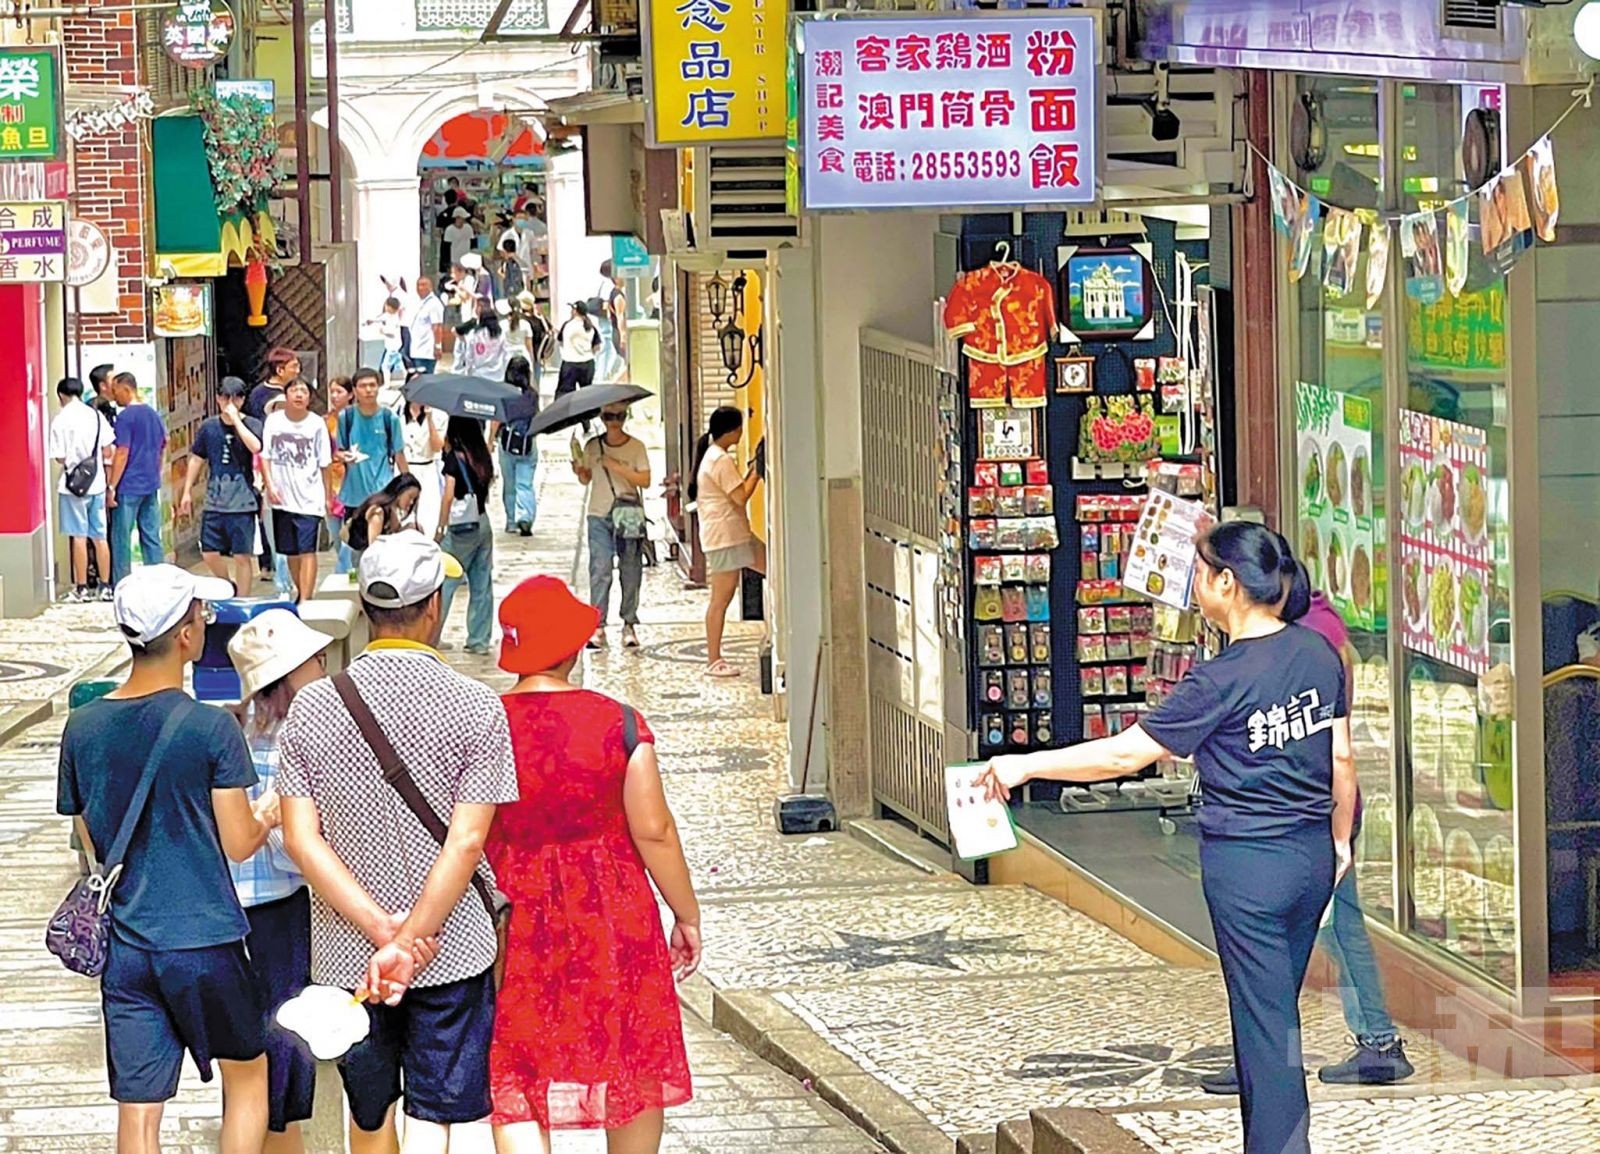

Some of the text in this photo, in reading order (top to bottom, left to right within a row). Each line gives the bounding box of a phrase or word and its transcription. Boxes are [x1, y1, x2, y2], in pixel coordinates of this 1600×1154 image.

[676, 0, 736, 128] 念品店
[758, 76, 768, 131] SHOP
[815, 50, 845, 173] 潮記美食
[858, 90, 1015, 130] 澳門筒骨
[1, 126, 49, 150] 魚旦
[0, 206, 53, 229] 合成
[11, 236, 61, 249] PERFUME
[0, 256, 55, 279] 香水
[1248, 688, 1334, 753] 錦記
